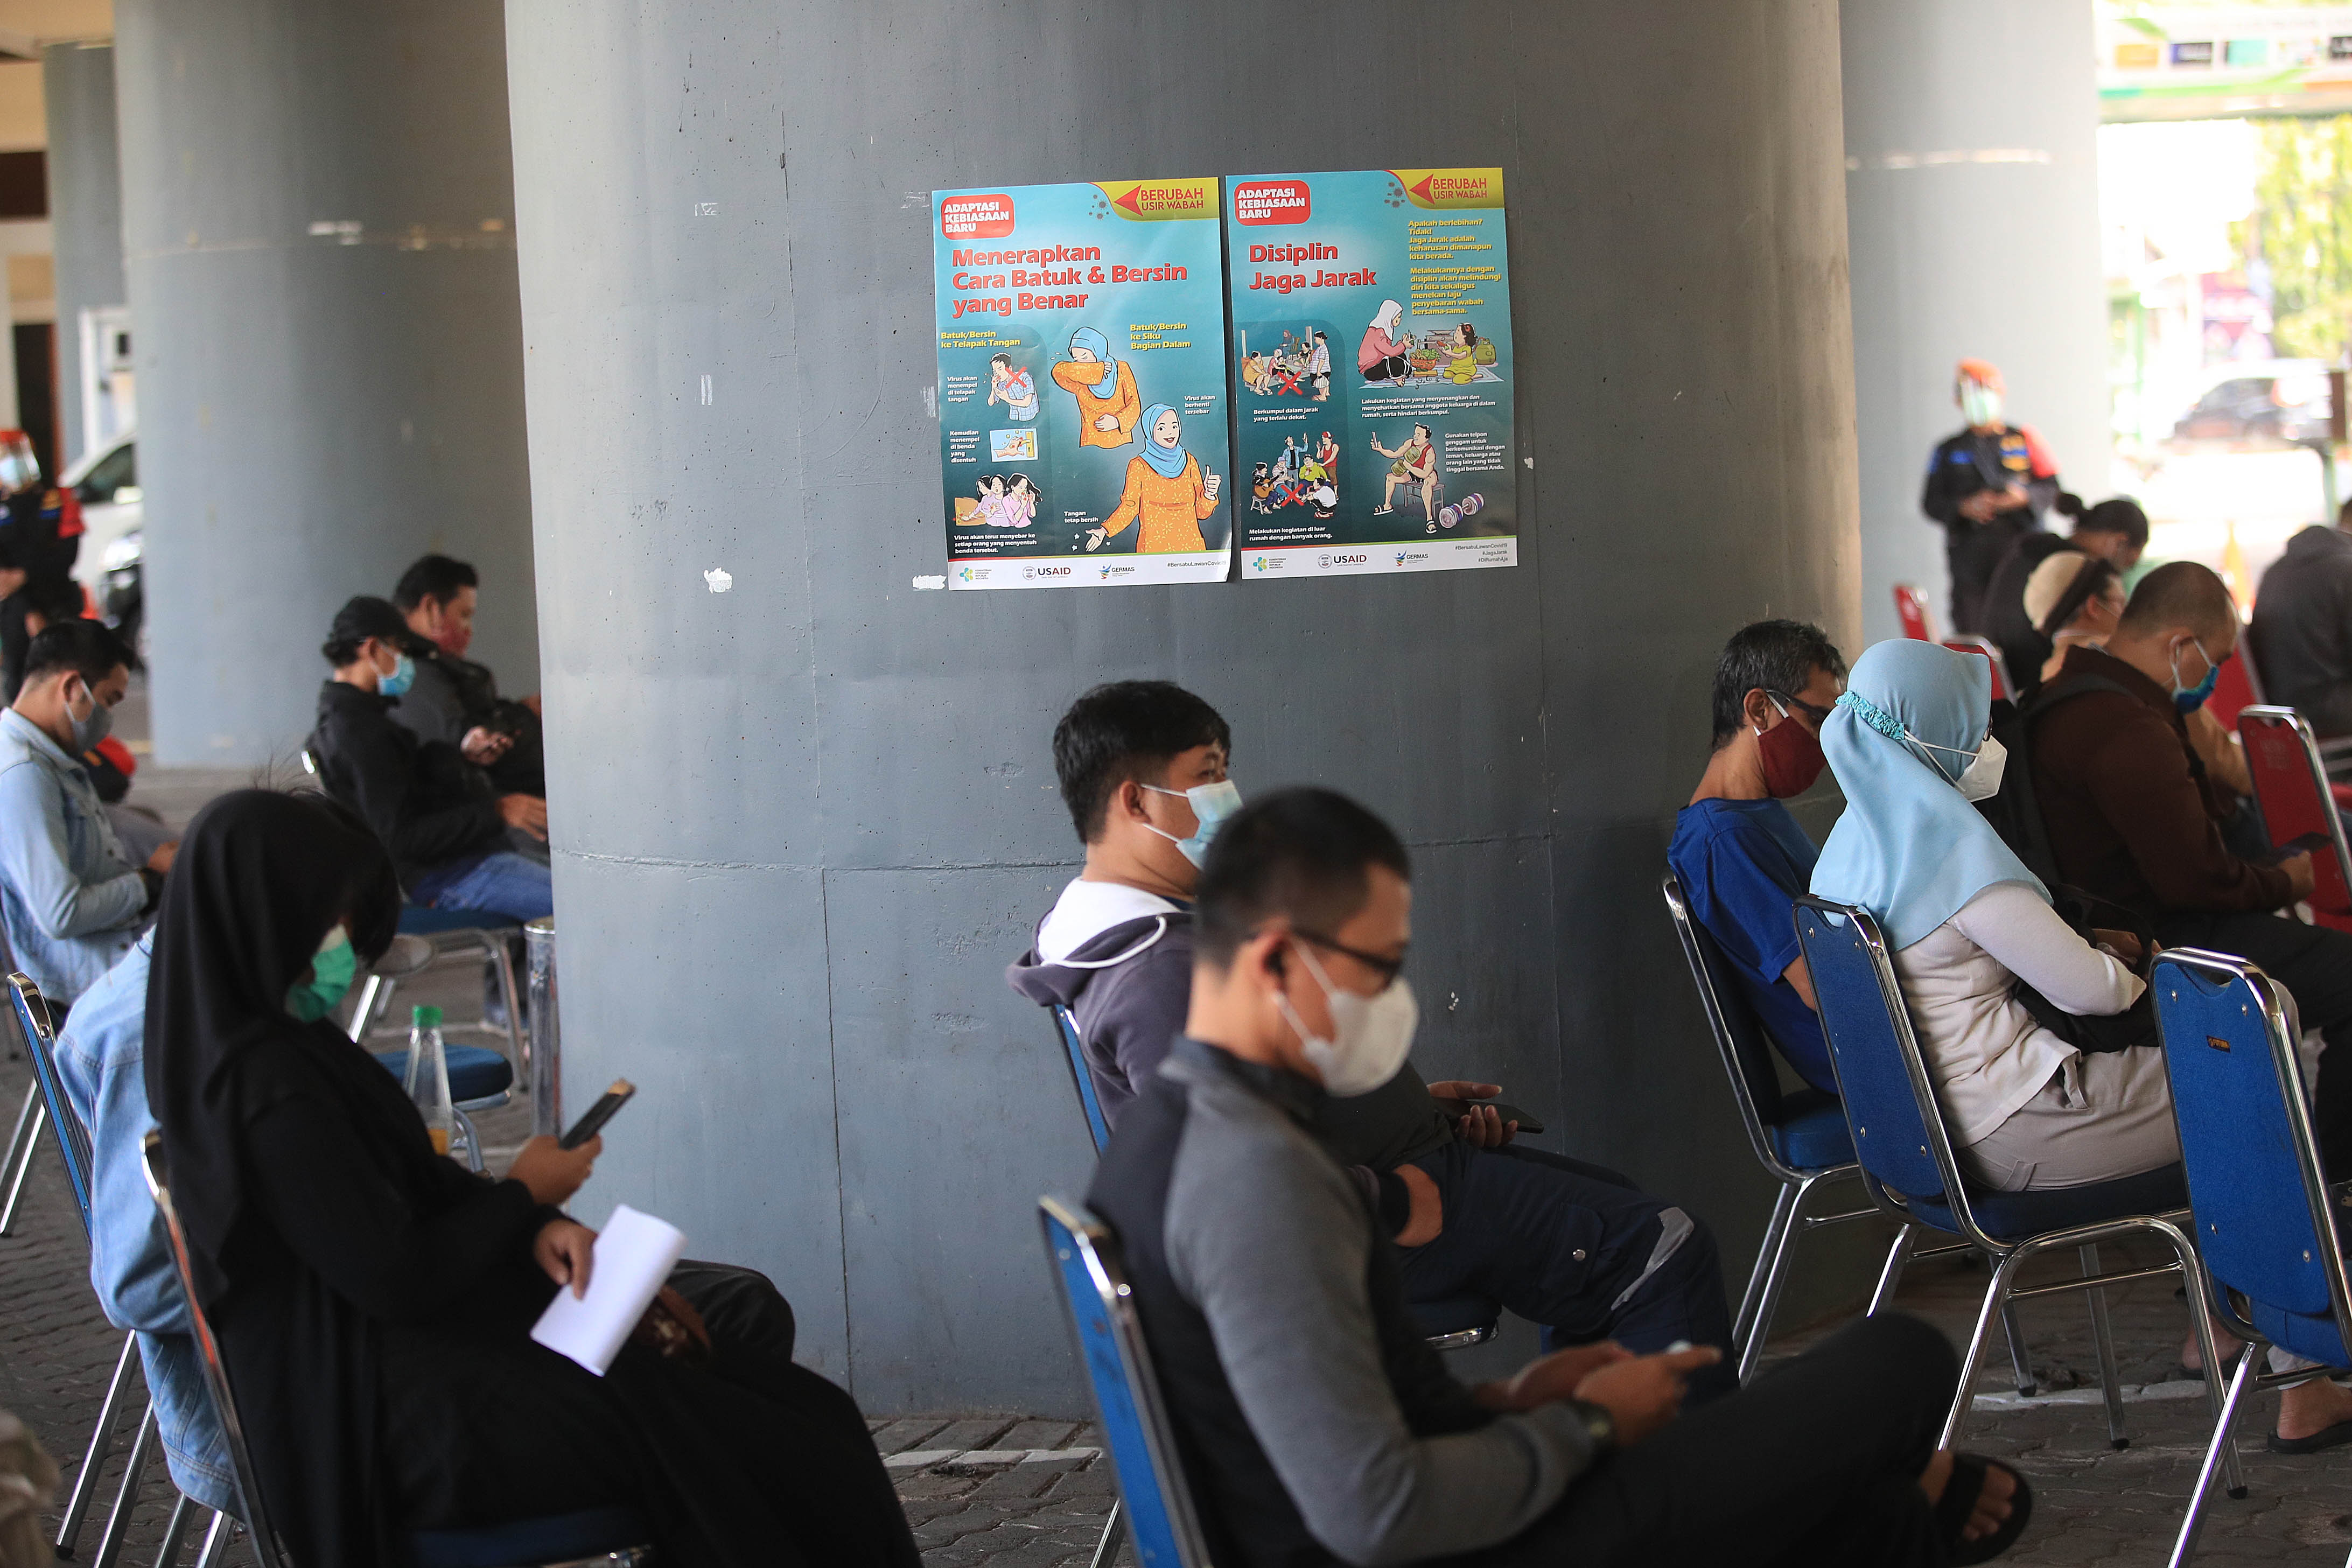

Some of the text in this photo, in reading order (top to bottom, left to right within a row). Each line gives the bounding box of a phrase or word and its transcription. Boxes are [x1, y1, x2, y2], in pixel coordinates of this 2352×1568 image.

[1433, 178, 1487, 190] BERUBAH
[1141, 188, 1203, 201] BERUBAH
[1237, 188, 1296, 199] ADAPTASI
[1434, 190, 1487, 199] USIR WABAH
[944, 202, 999, 213] ADAPTASI
[1142, 200, 1203, 211] USIR WABAH
[1238, 198, 1305, 209] KEBIASAAN
[945, 211, 1009, 223] KEBIASAAN
[1239, 209, 1271, 219] BARU
[946, 223, 976, 233] BARU
[1450, 243, 1492, 251] dimanapun
[952, 244, 1101, 267] Menerapkan
[1249, 242, 1338, 267] Disiplin
[952, 263, 1187, 290] Cara Batuk & Bersin
[1249, 268, 1377, 293] Jaga Jarak
[1459, 274, 1501, 282] melindungi
[1441, 283, 1475, 291] sekaligus
[952, 292, 1089, 318] yang Benar
[1412, 300, 1457, 308] penyebaran
[1130, 322, 1187, 332] Batuk/Bersin
[941, 331, 996, 340] Batuk/Bersin
[953, 340, 987, 348] Telapak
[988, 339, 1020, 347] Tangan
[1131, 342, 1161, 351] Bagian
[1334, 555, 1367, 563] USAID
